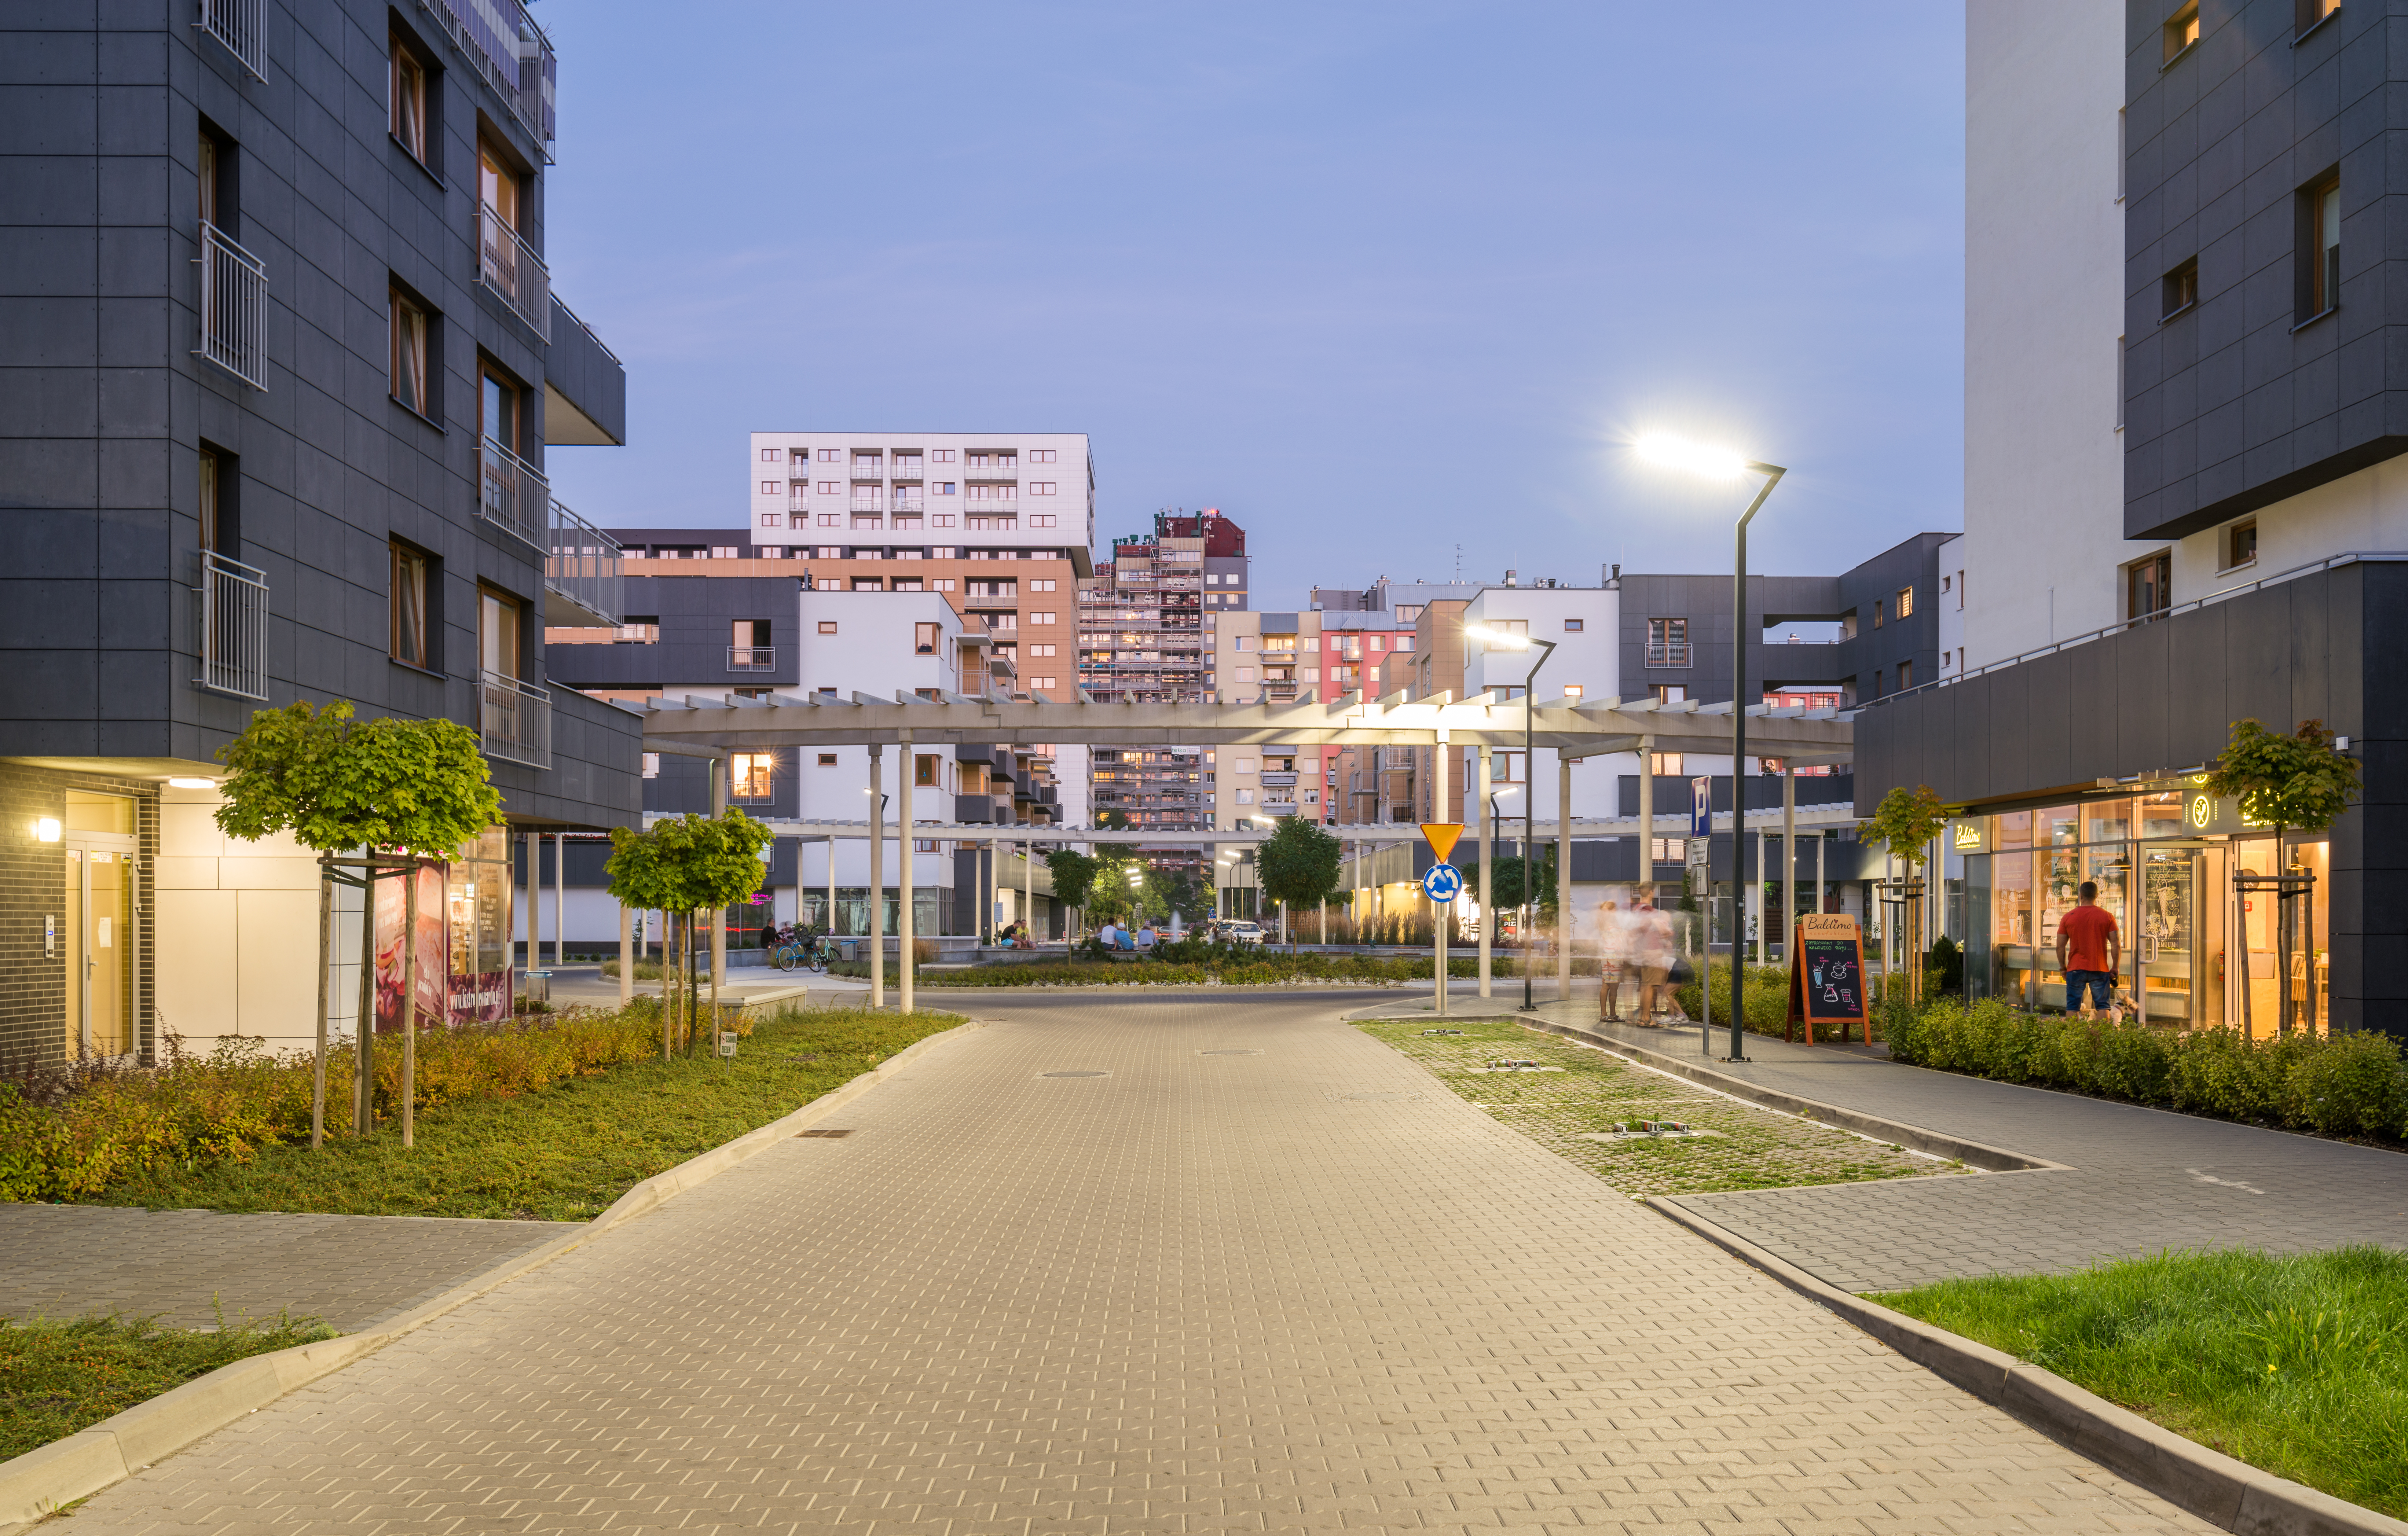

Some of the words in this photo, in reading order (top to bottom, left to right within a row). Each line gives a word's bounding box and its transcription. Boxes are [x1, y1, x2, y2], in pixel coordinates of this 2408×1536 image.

[1696, 784, 1706, 831] P
[1956, 825, 1980, 845] Baldimo
[378, 893, 396, 912] codziennie
[385, 911, 398, 926] nowego
[1808, 917, 1851, 929] Baldimo
[417, 979, 433, 1000] produkty
[450, 985, 500, 1010] www.bistroeonardo.pl
[726, 1035, 736, 1043] SZANUJ
